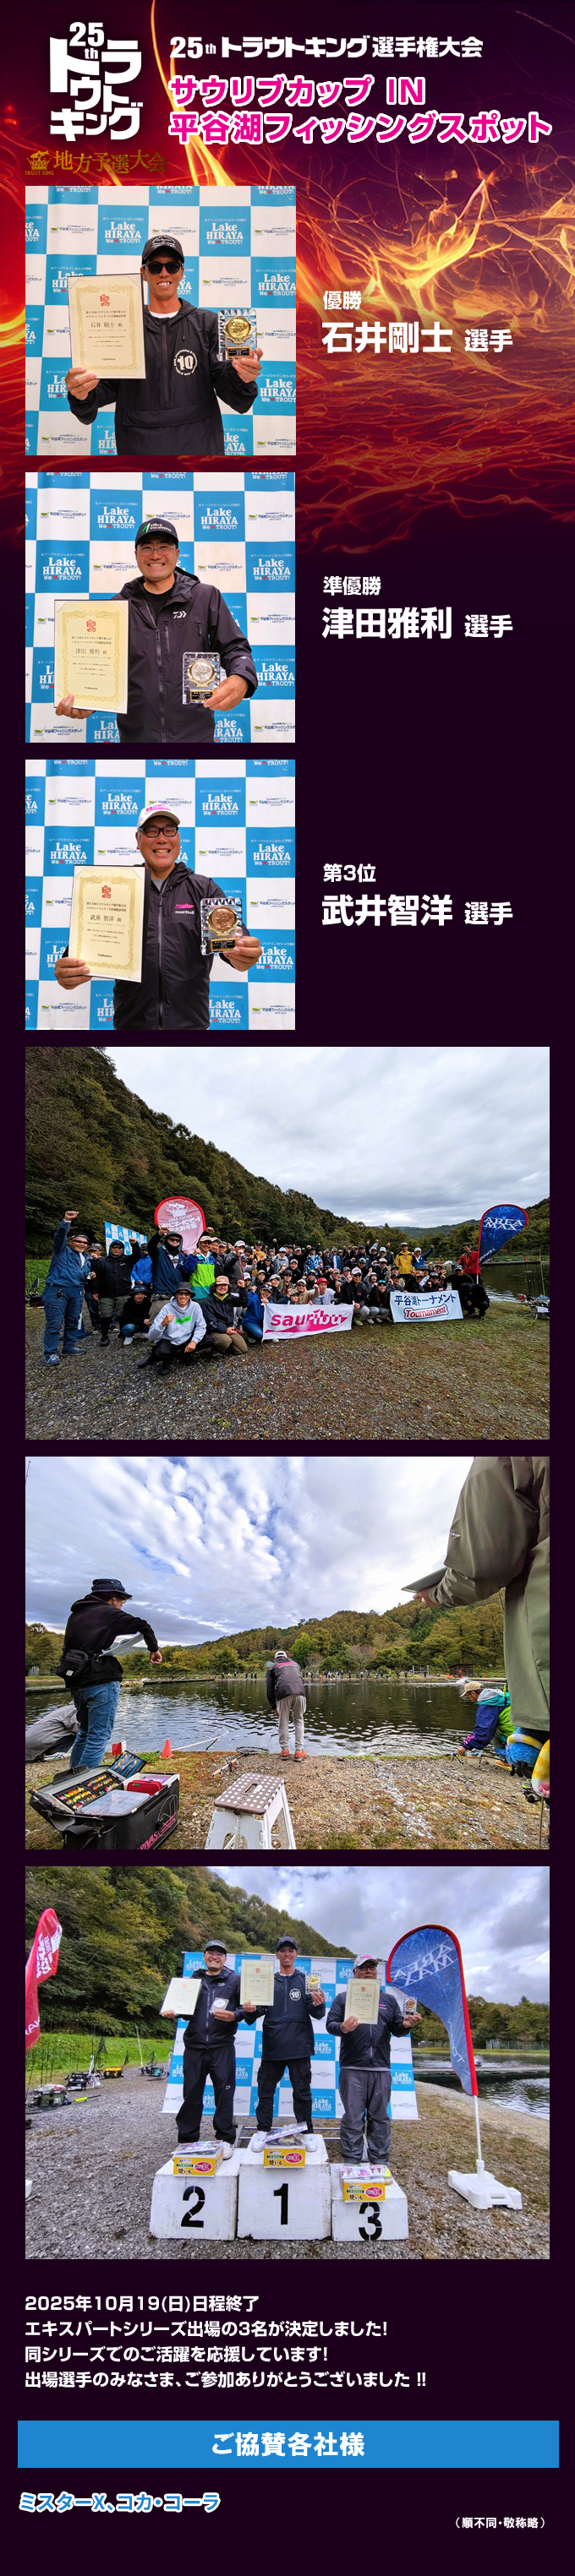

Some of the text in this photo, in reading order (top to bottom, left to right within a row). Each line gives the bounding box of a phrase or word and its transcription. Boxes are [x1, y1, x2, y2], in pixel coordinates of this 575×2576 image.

[264, 274, 290, 282] Lake
[259, 282, 296, 291] HIRAYA
[178, 356, 194, 370] 10
[266, 379, 293, 388] Lake
[206, 508, 232, 516] Lake
[49, 558, 75, 566] Lake
[259, 558, 284, 567] Lake
[262, 663, 288, 672] Lake
[108, 793, 132, 802] Lake
[259, 844, 284, 852] Lake
[262, 946, 287, 956] Lake
[209, 999, 234, 1009] Lake
[485, 1217, 523, 1226] AREA
[485, 1222, 517, 1230] MAX
[394, 1293, 456, 1305] 平谷湖トーナメント
[406, 1306, 446, 1318] Tournament
[271, 1309, 342, 1326] sauribu
[180, 2186, 205, 2228] 2
[273, 2183, 288, 2225] 1
[359, 2202, 382, 2241] 3
